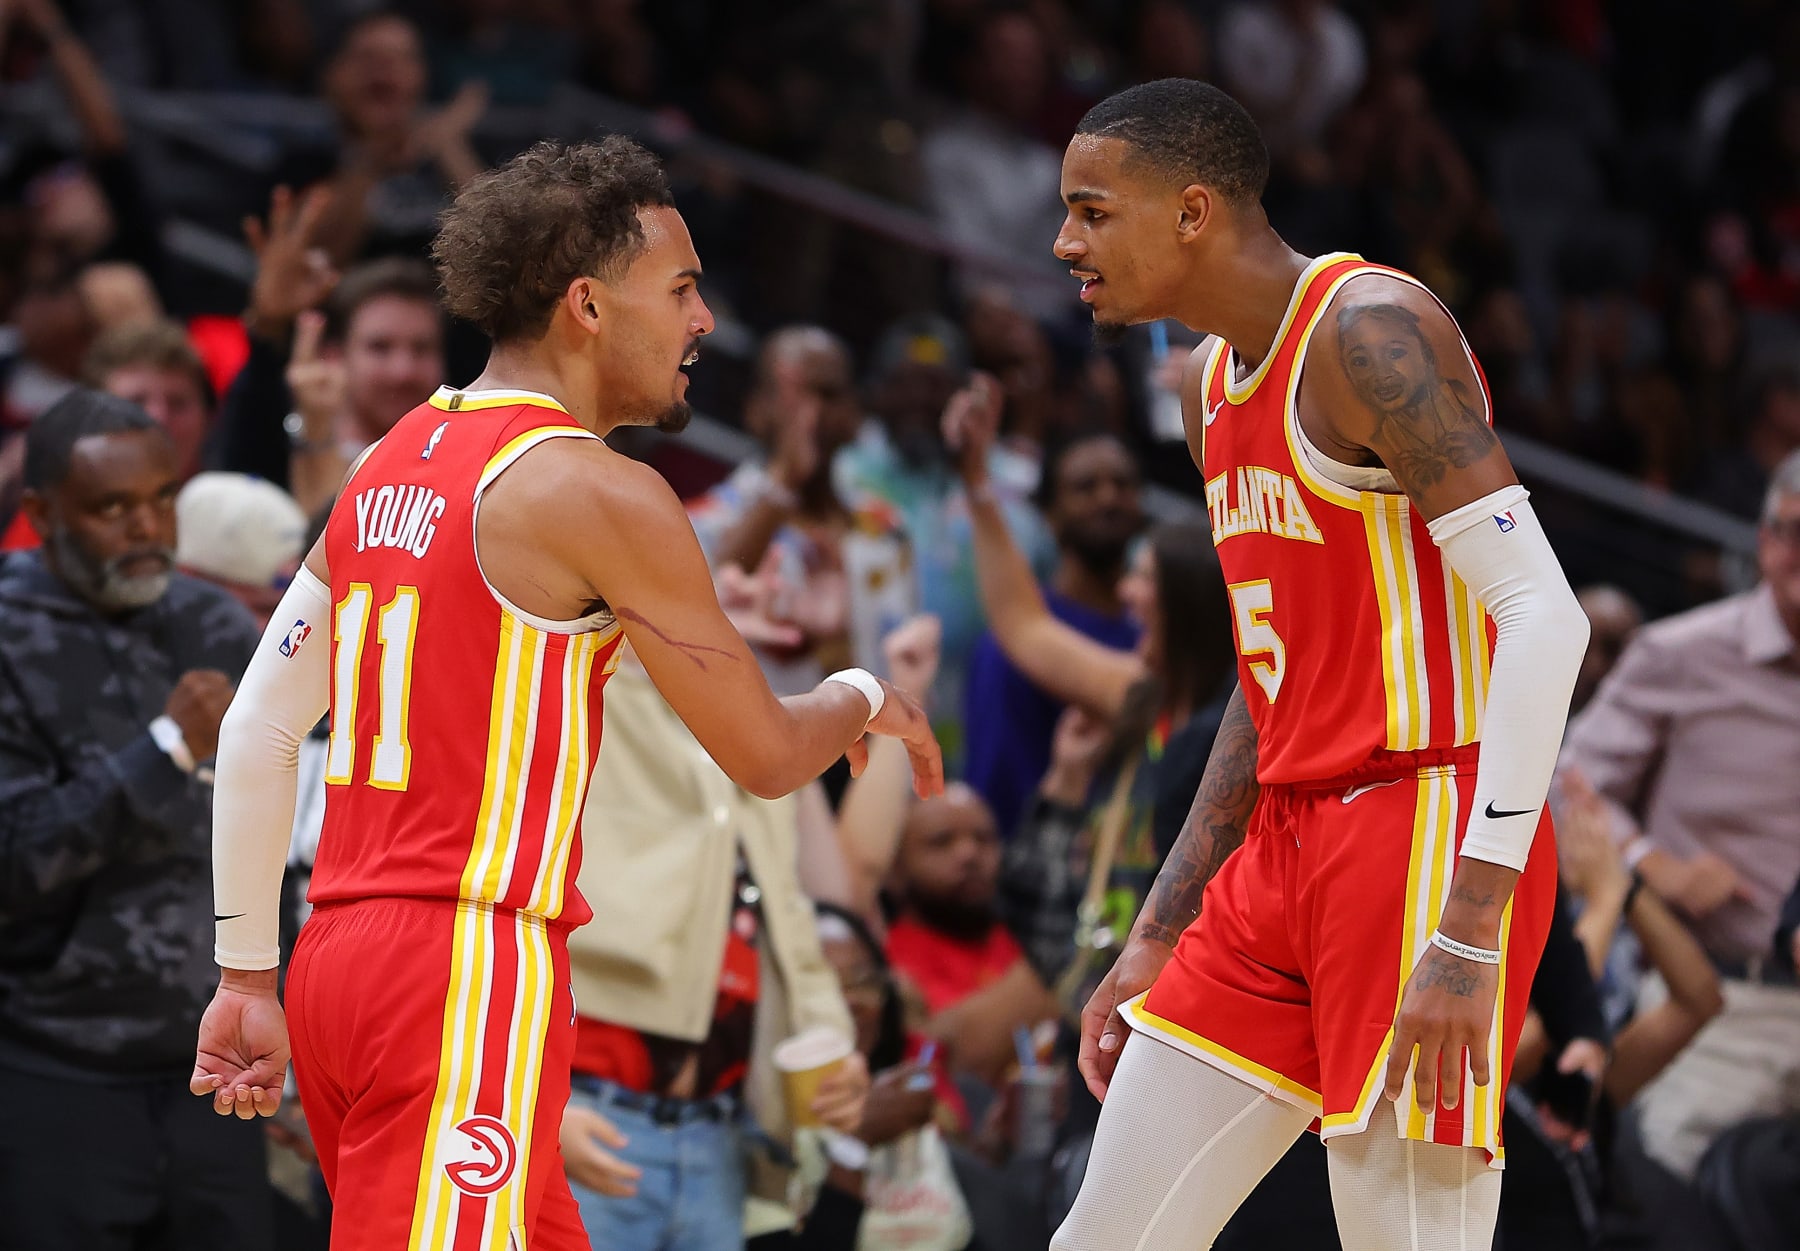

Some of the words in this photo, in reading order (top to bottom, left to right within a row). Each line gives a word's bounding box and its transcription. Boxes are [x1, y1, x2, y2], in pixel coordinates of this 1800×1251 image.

[355, 484, 446, 560] YOUNG
[1205, 466, 1325, 548] TLANTA
[325, 582, 420, 791] 11
[1227, 578, 1286, 705] 5
